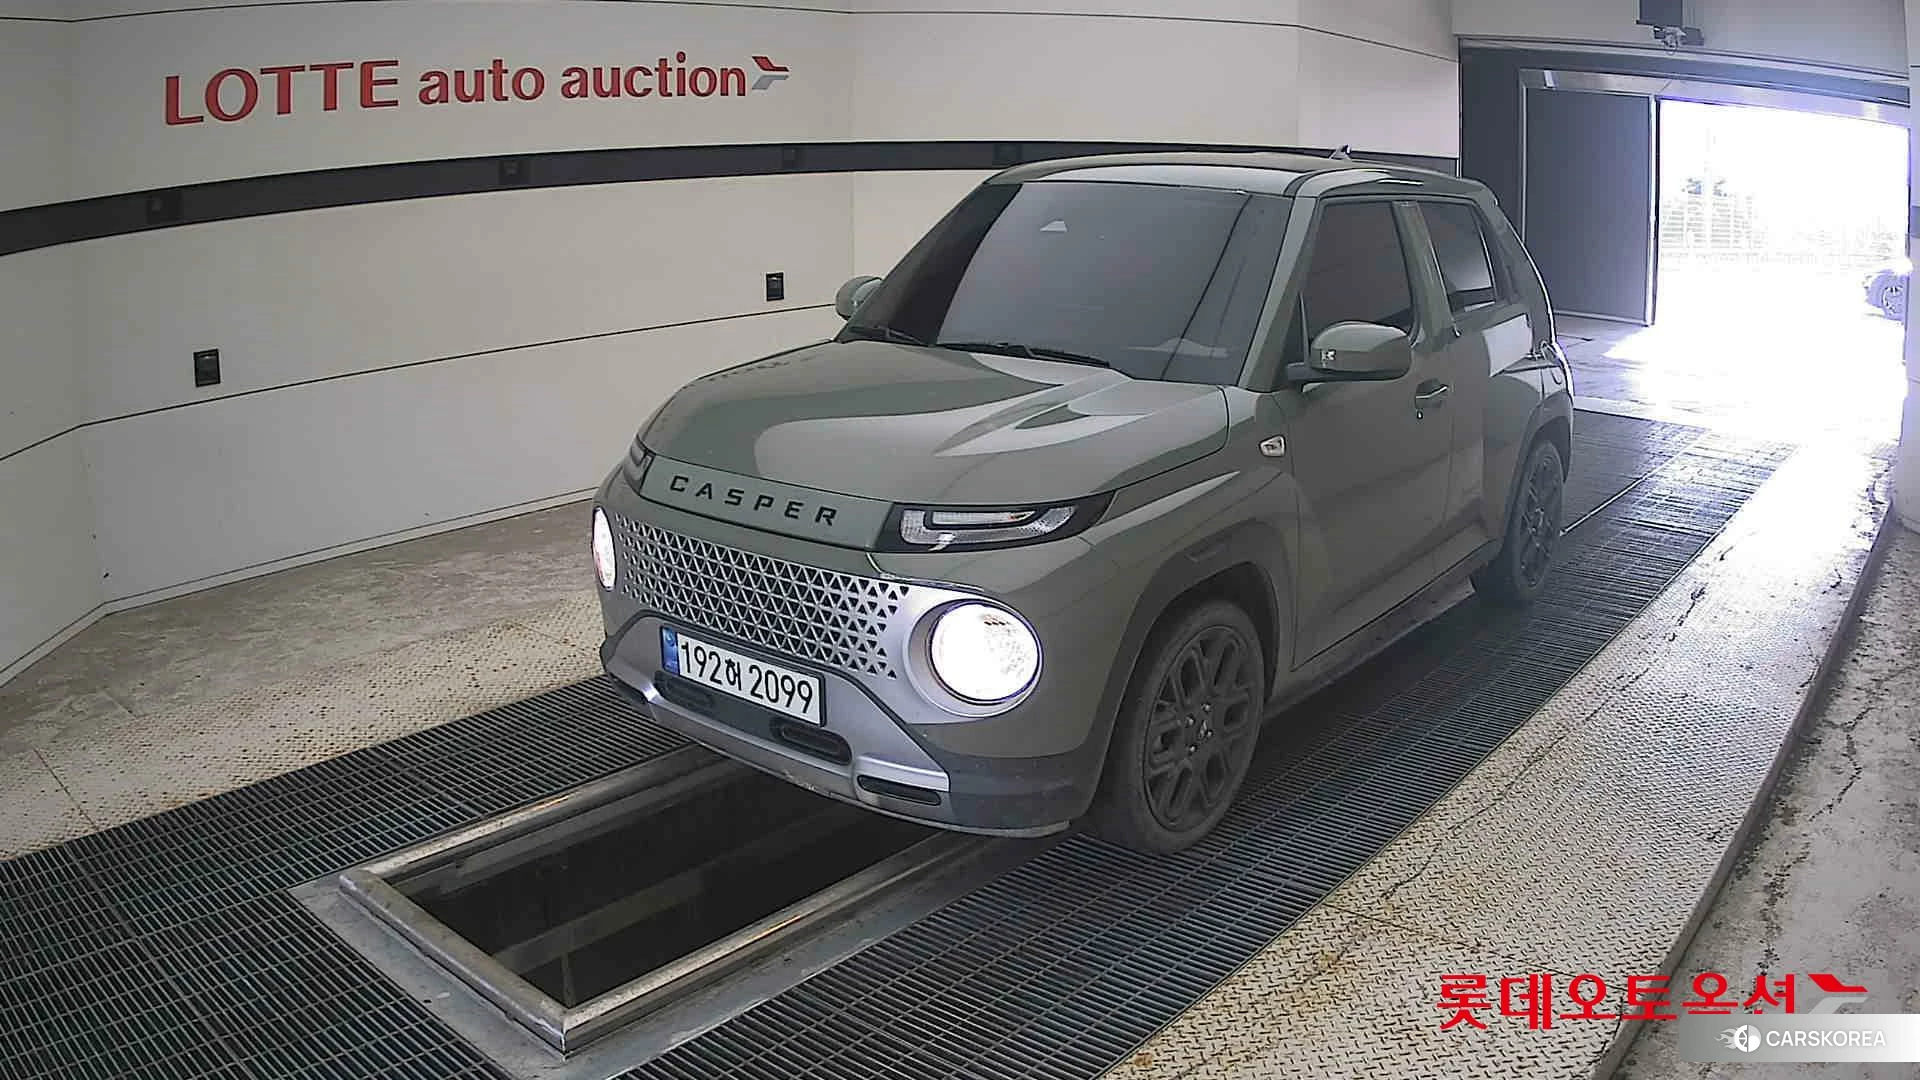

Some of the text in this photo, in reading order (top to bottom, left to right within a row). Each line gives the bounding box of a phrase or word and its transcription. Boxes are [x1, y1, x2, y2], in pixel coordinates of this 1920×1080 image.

[164, 51, 748, 125] LOTTE auto auction
[669, 475, 838, 526] CASPER
[681, 641, 813, 714] 192허 2099
